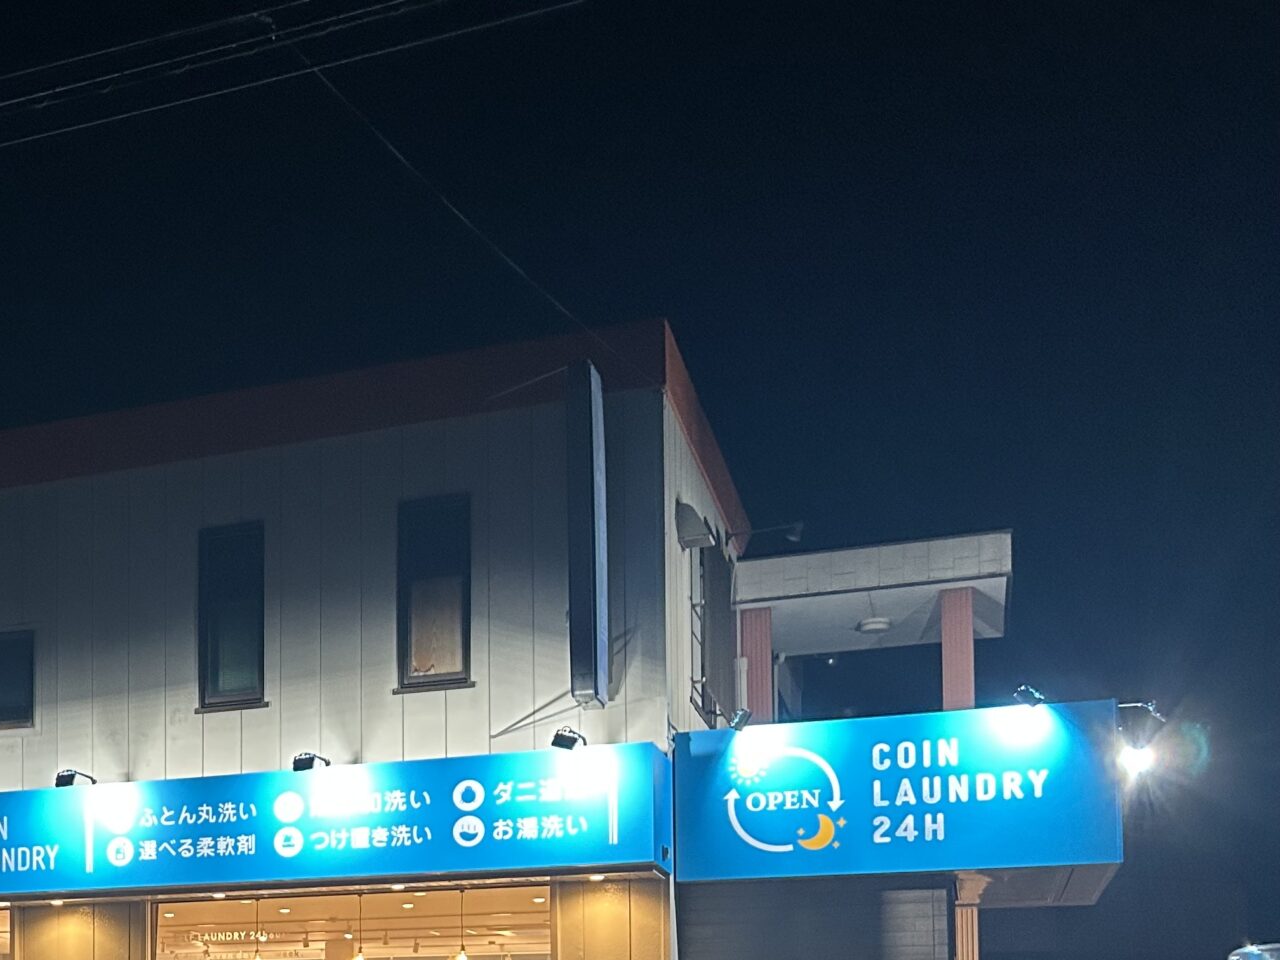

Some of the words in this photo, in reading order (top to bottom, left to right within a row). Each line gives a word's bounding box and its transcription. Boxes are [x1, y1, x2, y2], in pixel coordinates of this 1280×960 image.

[872, 738, 959, 771] COIN
[746, 789, 822, 813] OPEN
[872, 770, 1050, 809] LAUNDRY
[139, 803, 257, 827] ふとん丸洗い
[492, 815, 588, 840] お湯洗い
[310, 825, 432, 850] つけ置き洗い
[872, 813, 945, 845] 24H
[138, 834, 257, 861] 選べる柔軟剤
[198, 931, 245, 941] LAUNDRY
